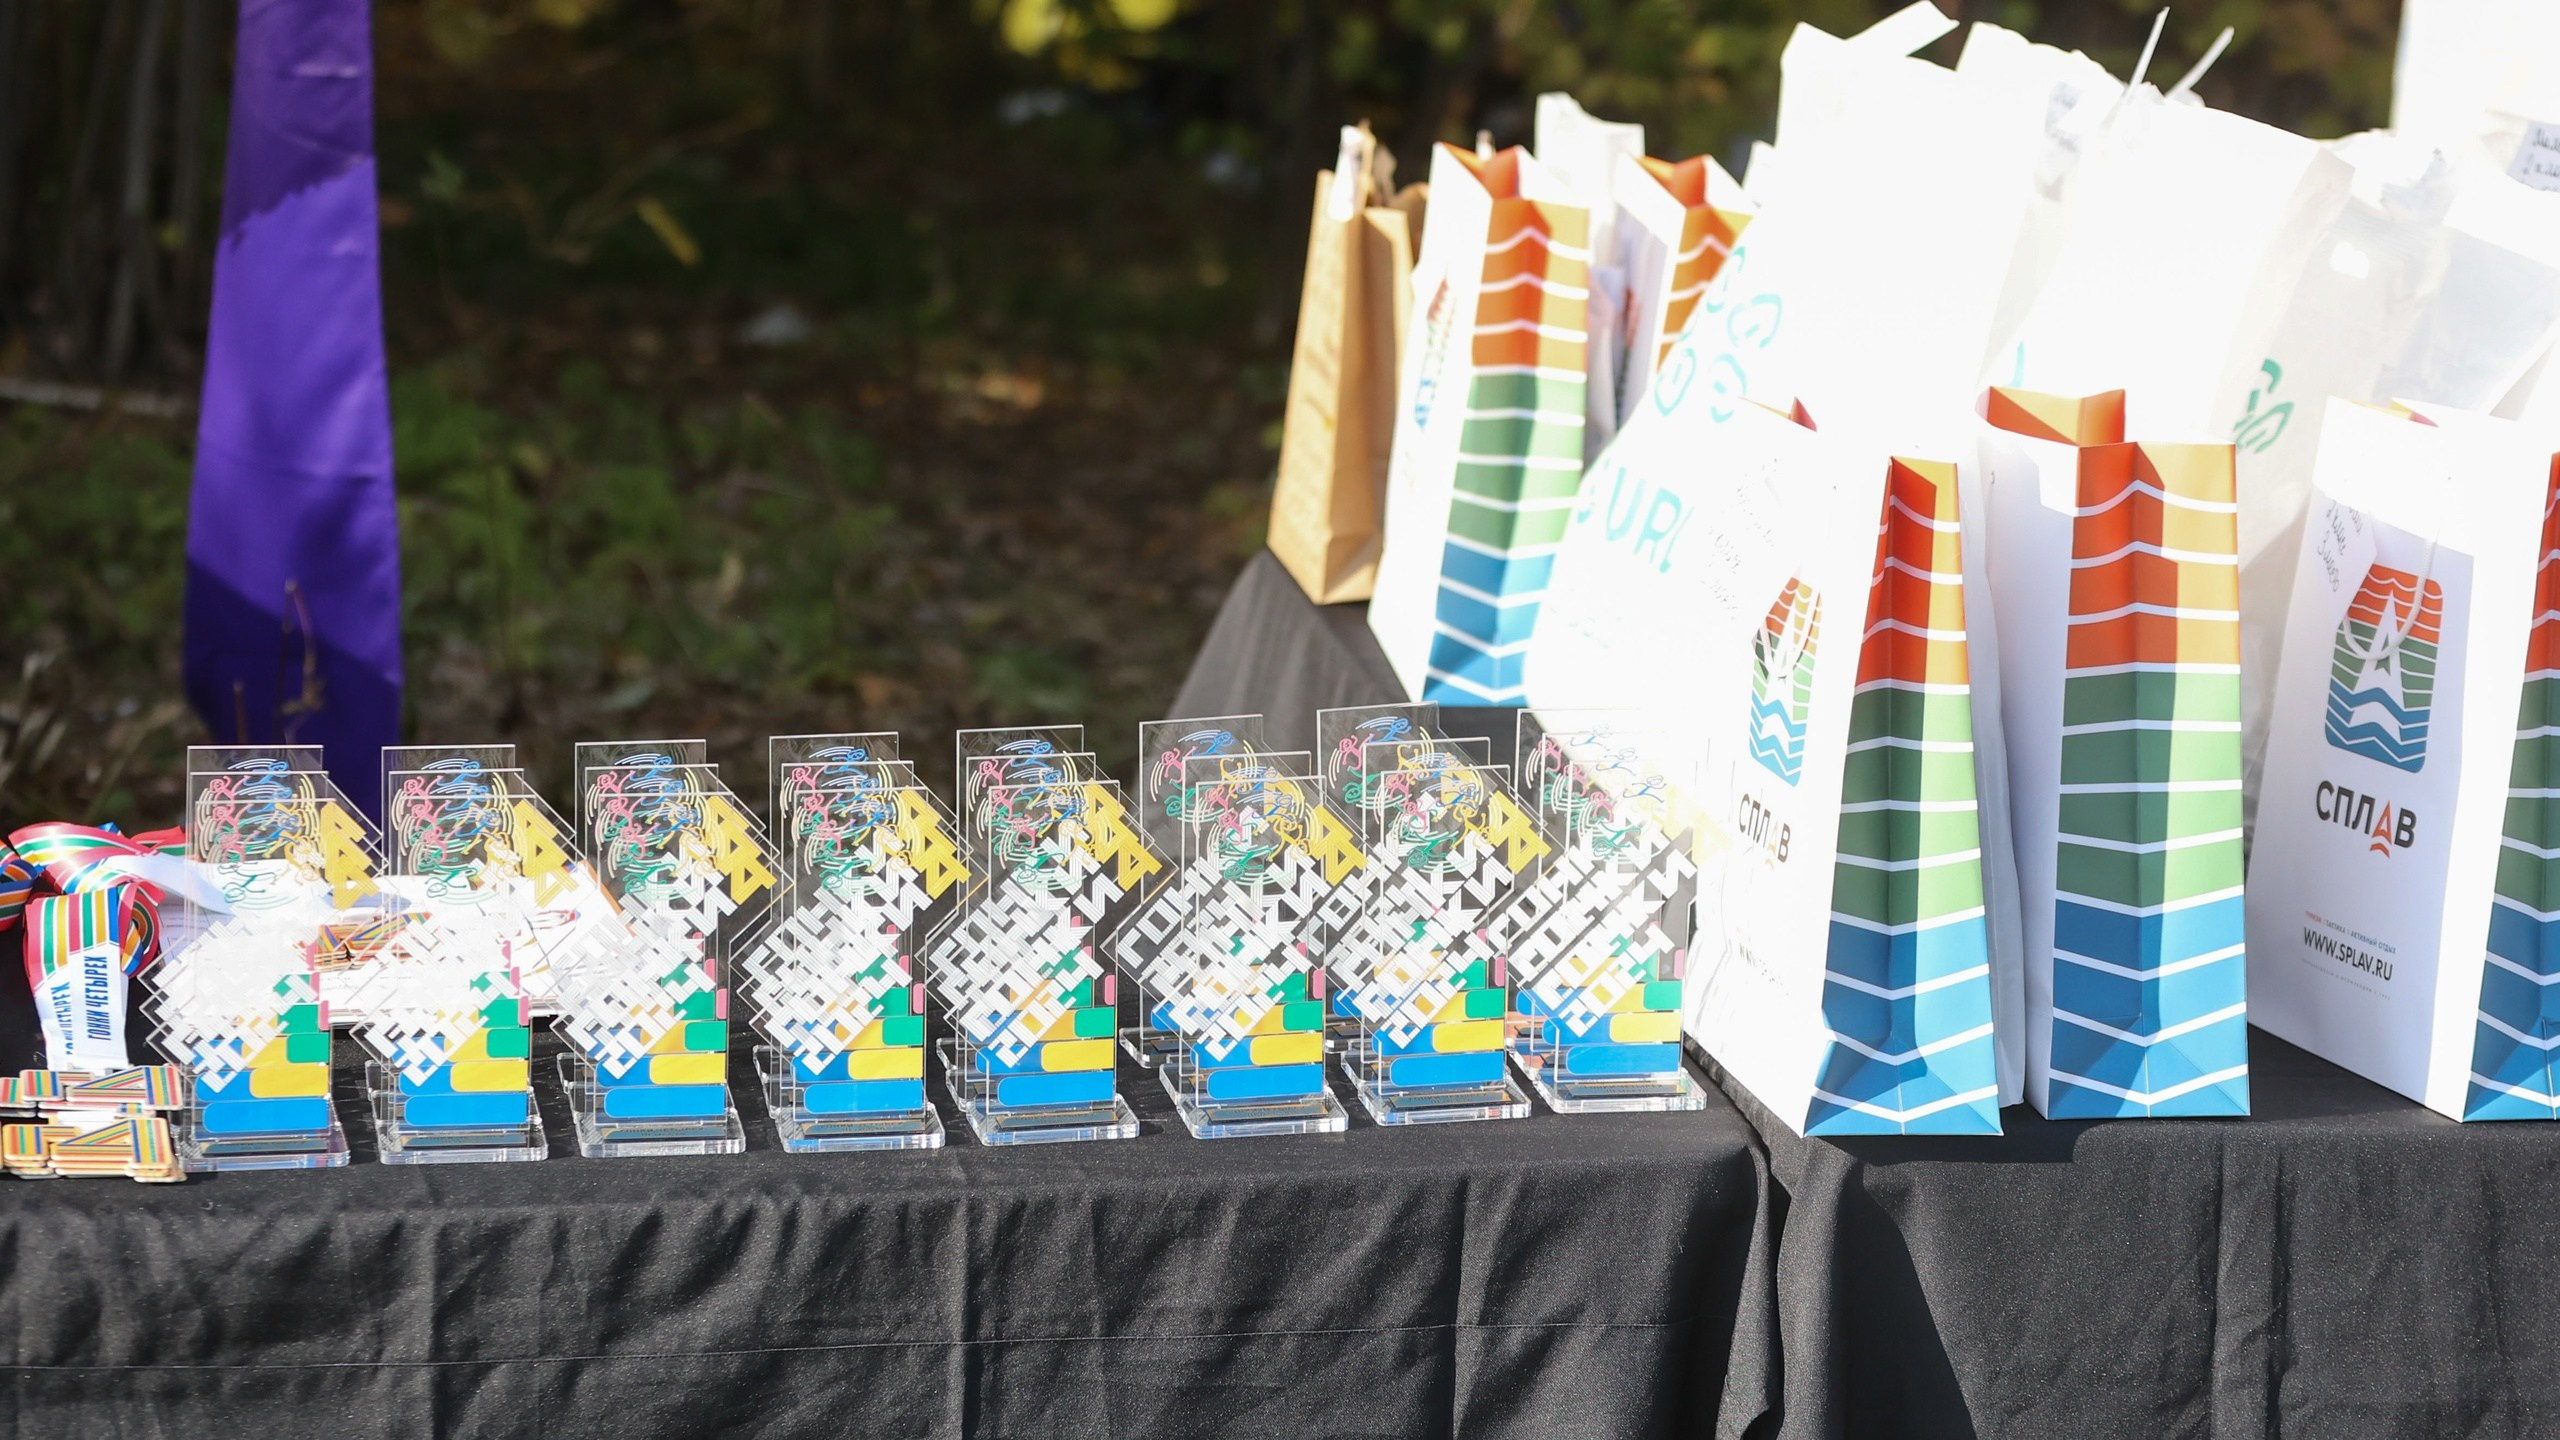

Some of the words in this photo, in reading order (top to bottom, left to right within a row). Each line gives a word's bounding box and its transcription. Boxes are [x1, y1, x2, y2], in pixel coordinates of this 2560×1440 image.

[1739, 793, 1791, 863] СПЛАВ
[2316, 780, 2417, 850] СПЛАВ
[84, 955, 108, 1007] ЧЕТЫРЕХ
[2303, 926, 2393, 981] WWW.SPLAV.RU
[86, 1009, 111, 1041] ГОНКИ
